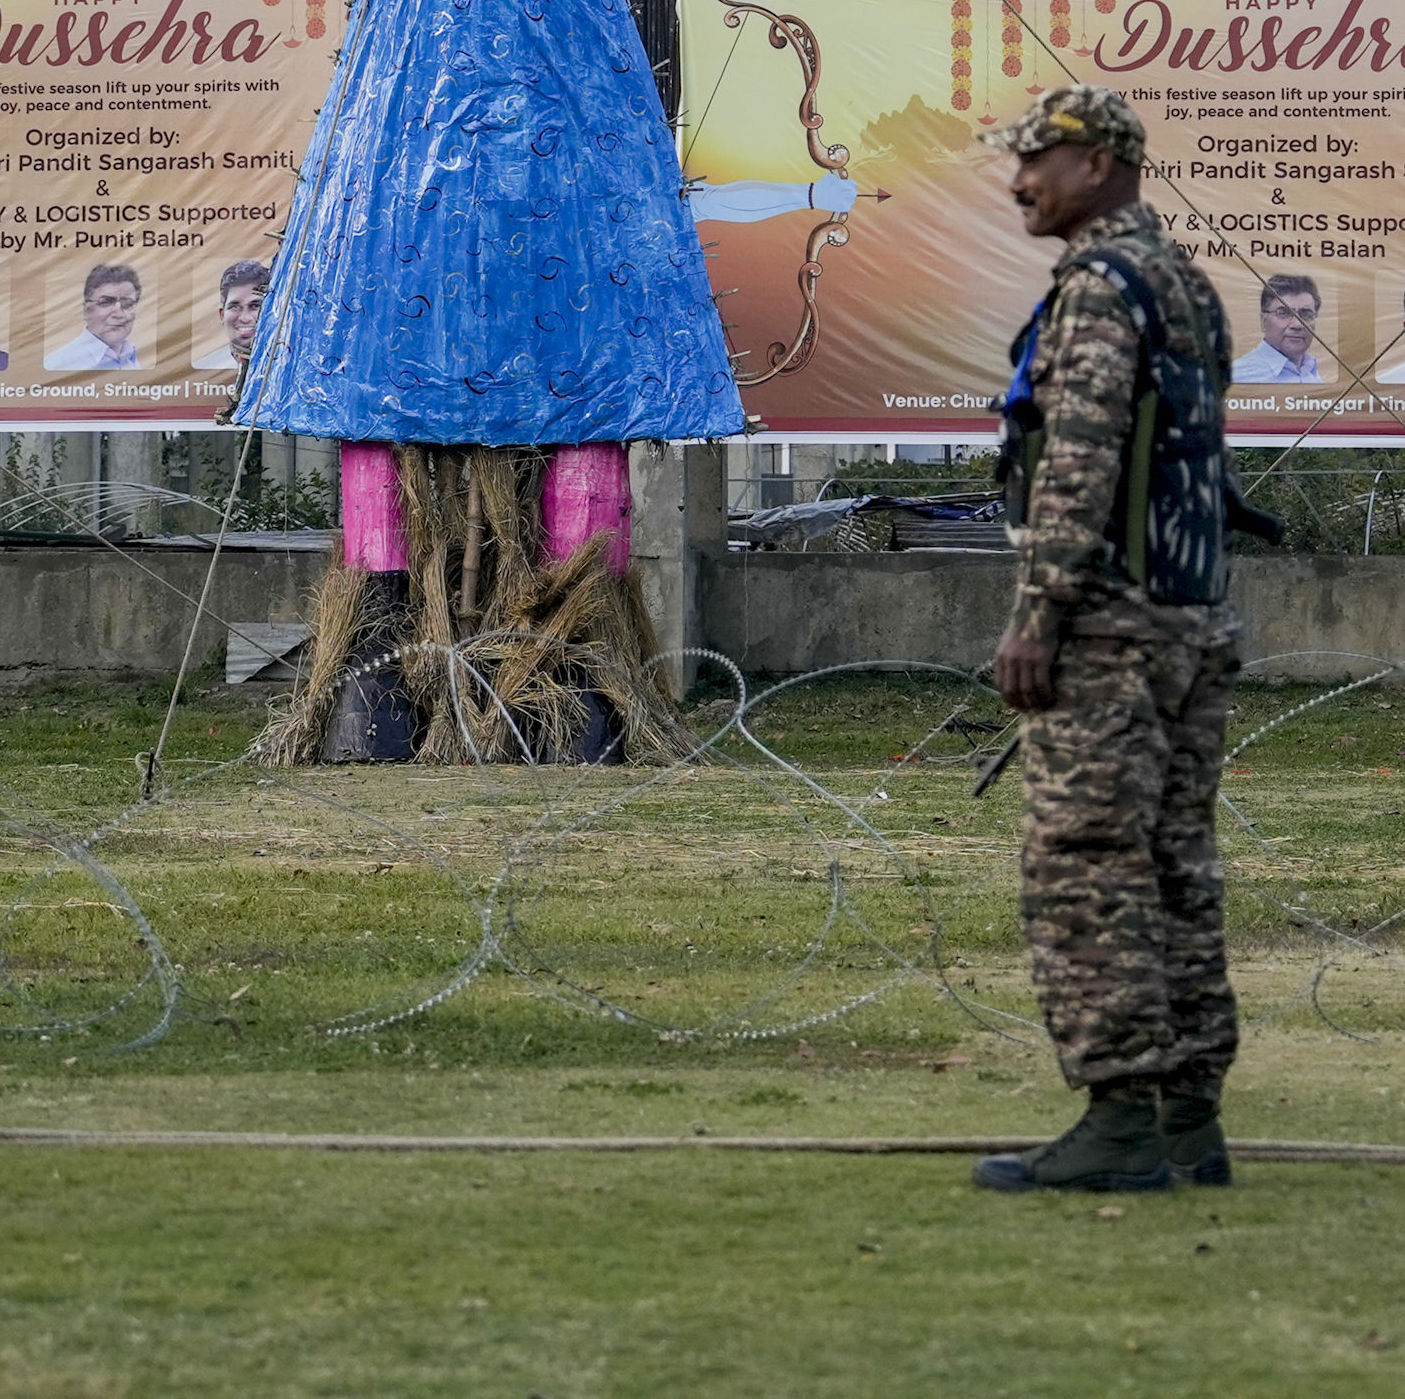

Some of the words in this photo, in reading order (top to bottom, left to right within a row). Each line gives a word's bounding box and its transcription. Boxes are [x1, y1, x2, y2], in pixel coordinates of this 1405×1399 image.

[49, 84, 101, 94] season
[106, 80, 127, 93] lift
[131, 82, 152, 98] up
[156, 82, 191, 97] your
[194, 79, 241, 96] spirits
[245, 79, 280, 92] with
[1132, 87, 1161, 101] this
[1166, 87, 1217, 101] festive
[1222, 90, 1275, 101] season
[1281, 87, 1303, 100] lift
[1308, 89, 1328, 105] up
[1333, 89, 1368, 104] your
[26, 101, 70, 114] peace
[75, 98, 103, 111] and
[108, 97, 212, 110] contentment.
[1164, 104, 1192, 120] joy,
[1197, 107, 1244, 120] peace
[1249, 104, 1278, 118] and
[1283, 104, 1391, 118] contentment.
[25, 128, 140, 149] Organized
[149, 127, 180, 148] by:
[1197, 135, 1317, 157] Organized
[1326, 135, 1358, 156] by:
[18, 154, 92, 172] Pandit
[98, 152, 215, 174] Sangarash
[222, 151, 294, 169] Samiti
[1190, 160, 1266, 179] Pandit
[1274, 160, 1395, 181] Sangarash
[95, 179, 110, 196] &
[1271, 188, 1286, 205] &
[13, 206, 28, 222] &
[35, 204, 150, 222] LOGISTICS
[157, 202, 277, 225] Supported
[1186, 214, 1201, 231] &
[1209, 213, 1328, 231] LOGISTICS
[0, 231, 26, 251] by
[34, 231, 68, 248] Mr.
[75, 230, 135, 248] Punit
[142, 229, 204, 247] Balan
[1250, 239, 1312, 258] Punit
[1321, 240, 1385, 258] Balan
[29, 383, 100, 400] Ground,
[104, 381, 180, 401] Srinagar
[882, 394, 945, 408] Venue:
[1225, 396, 1280, 412] ound,
[1285, 396, 1365, 414] Srinagar
